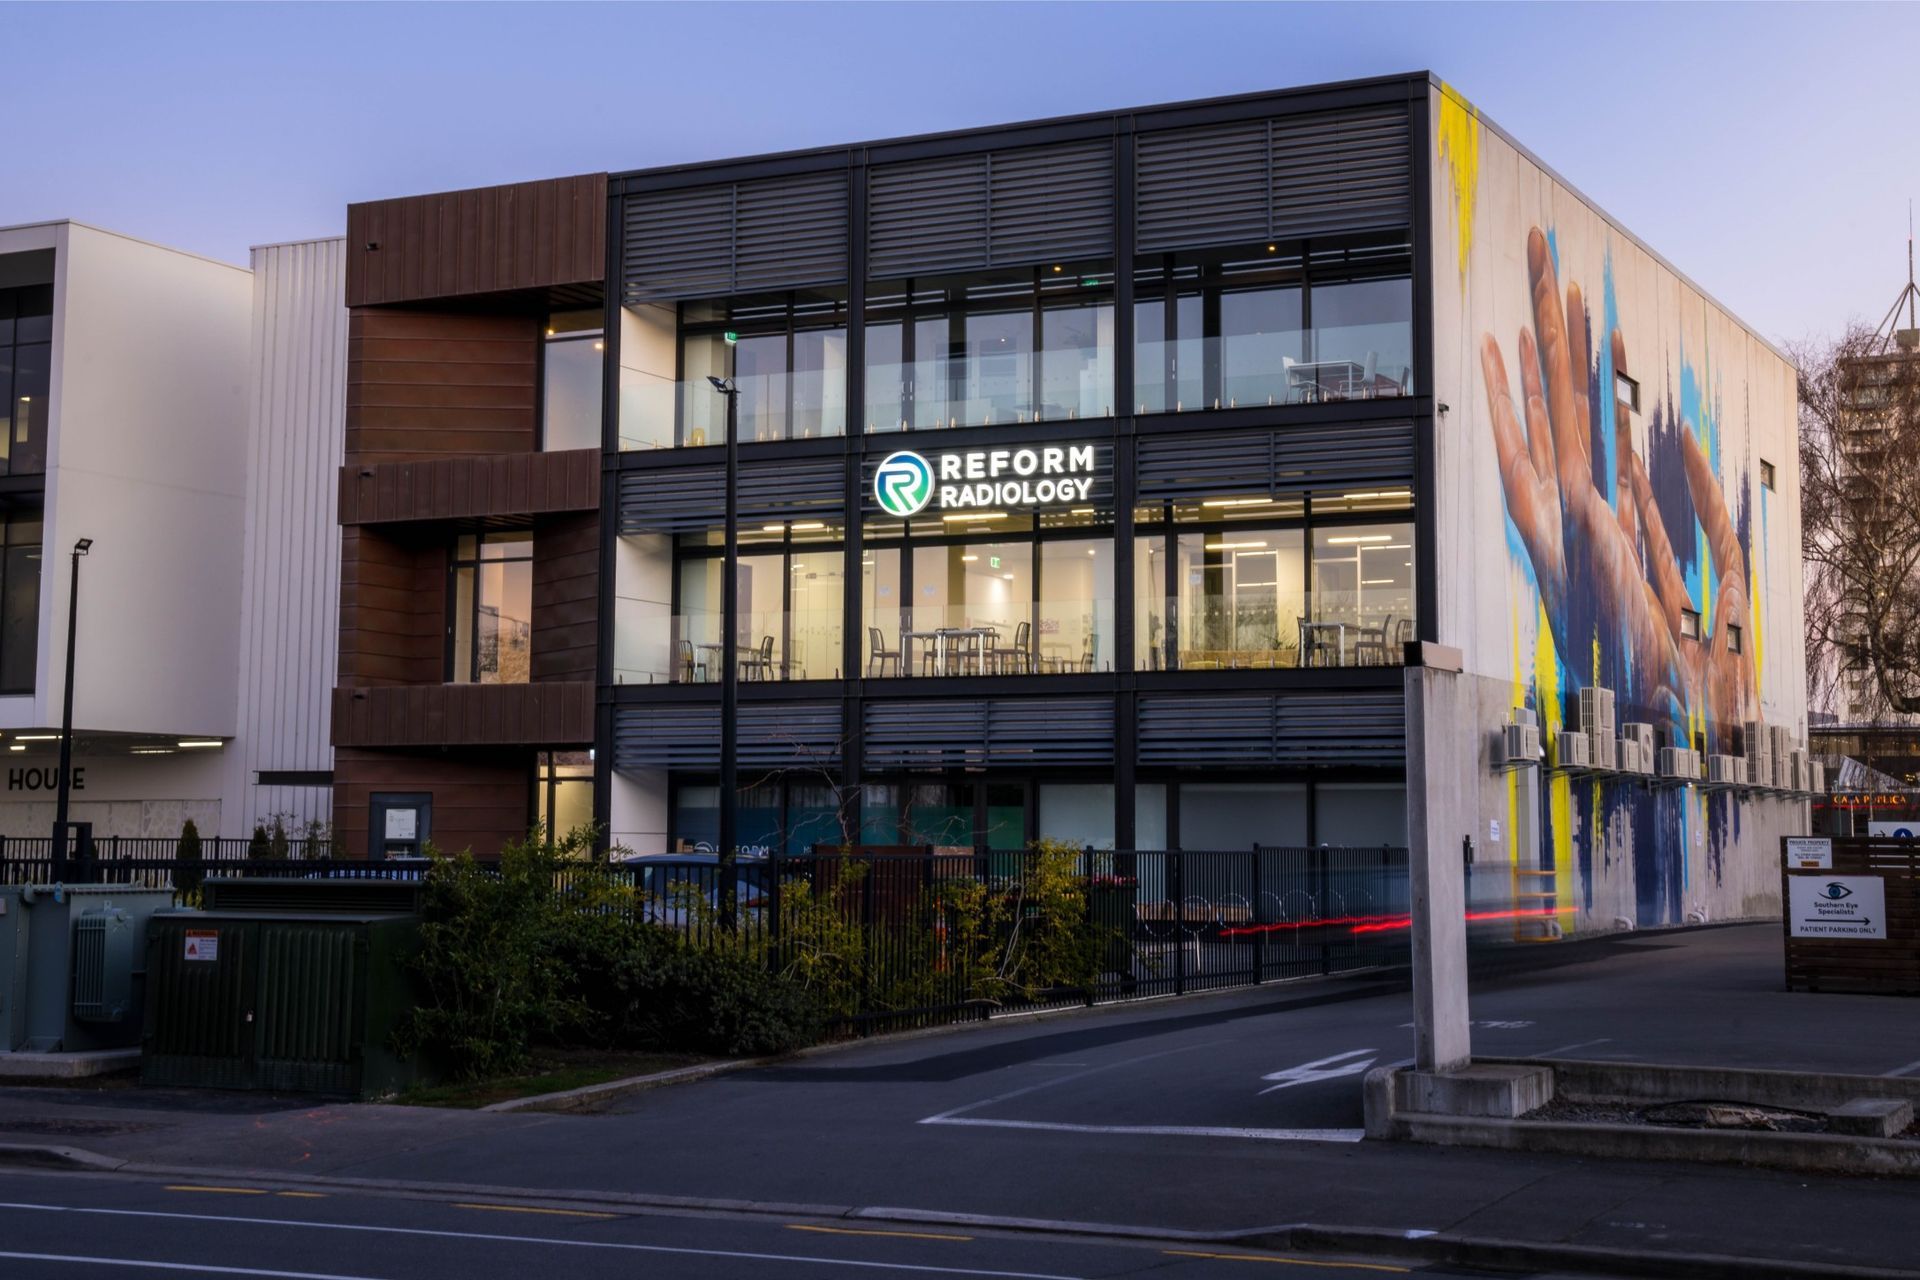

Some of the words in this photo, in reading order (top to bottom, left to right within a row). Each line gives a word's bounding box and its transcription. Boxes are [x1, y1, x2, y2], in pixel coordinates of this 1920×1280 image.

[941, 445, 1095, 480] REFORM
[940, 477, 1095, 508] RADIOLOGY
[8, 767, 85, 791] HOUE
[1833, 795, 1860, 804] CAA
[1818, 908, 1854, 916] Specialists
[1846, 902, 1858, 910] Eye
